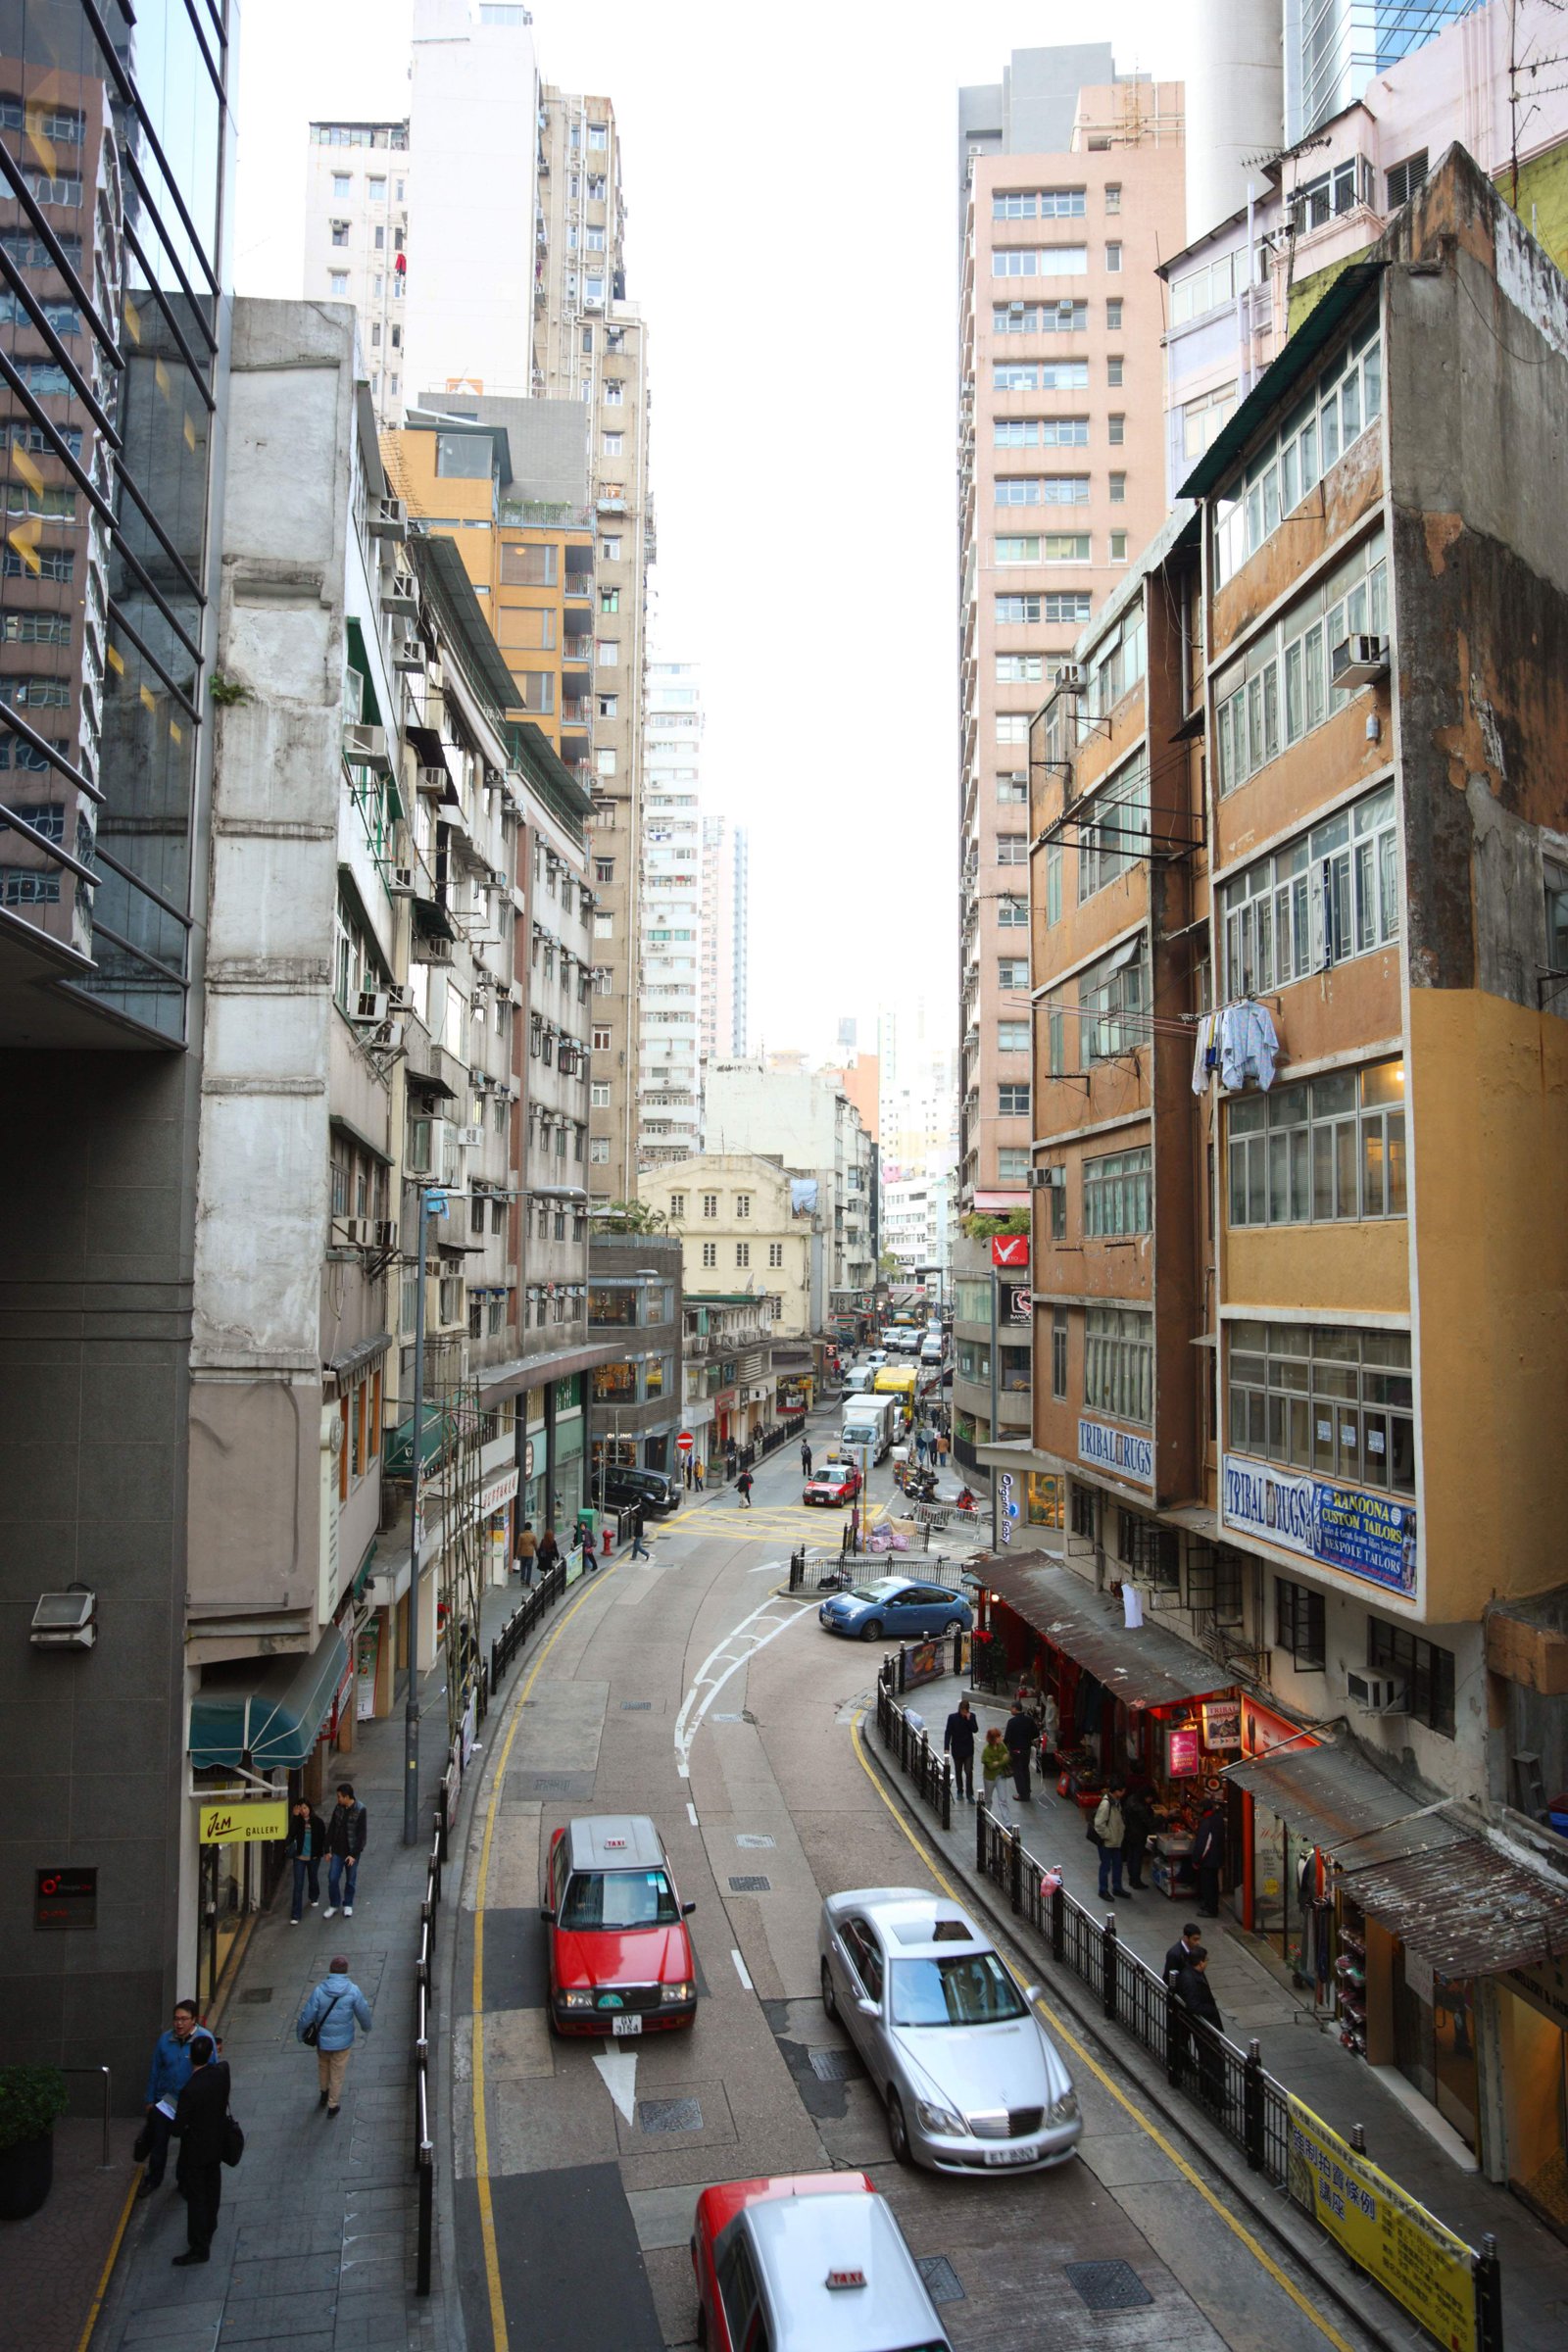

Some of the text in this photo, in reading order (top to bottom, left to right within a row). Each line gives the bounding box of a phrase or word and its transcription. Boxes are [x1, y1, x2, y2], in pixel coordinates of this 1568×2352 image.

[1080, 1422, 1115, 1462] TRIBAL
[1123, 1436, 1152, 1476] RUGS
[1227, 1469, 1265, 1524] TRIBAL
[1275, 1483, 1305, 1540] RUGS
[1333, 1492, 1390, 1522] RANOONA
[1322, 1508, 1402, 1544] CUSTOM TAILORS
[1364, 1549, 1400, 1574] TAILORS
[1209, 1705, 1238, 1714] TRIBAL
[246, 1827, 278, 1837] GALLERY
[832, 2272, 862, 2283] TAXI
